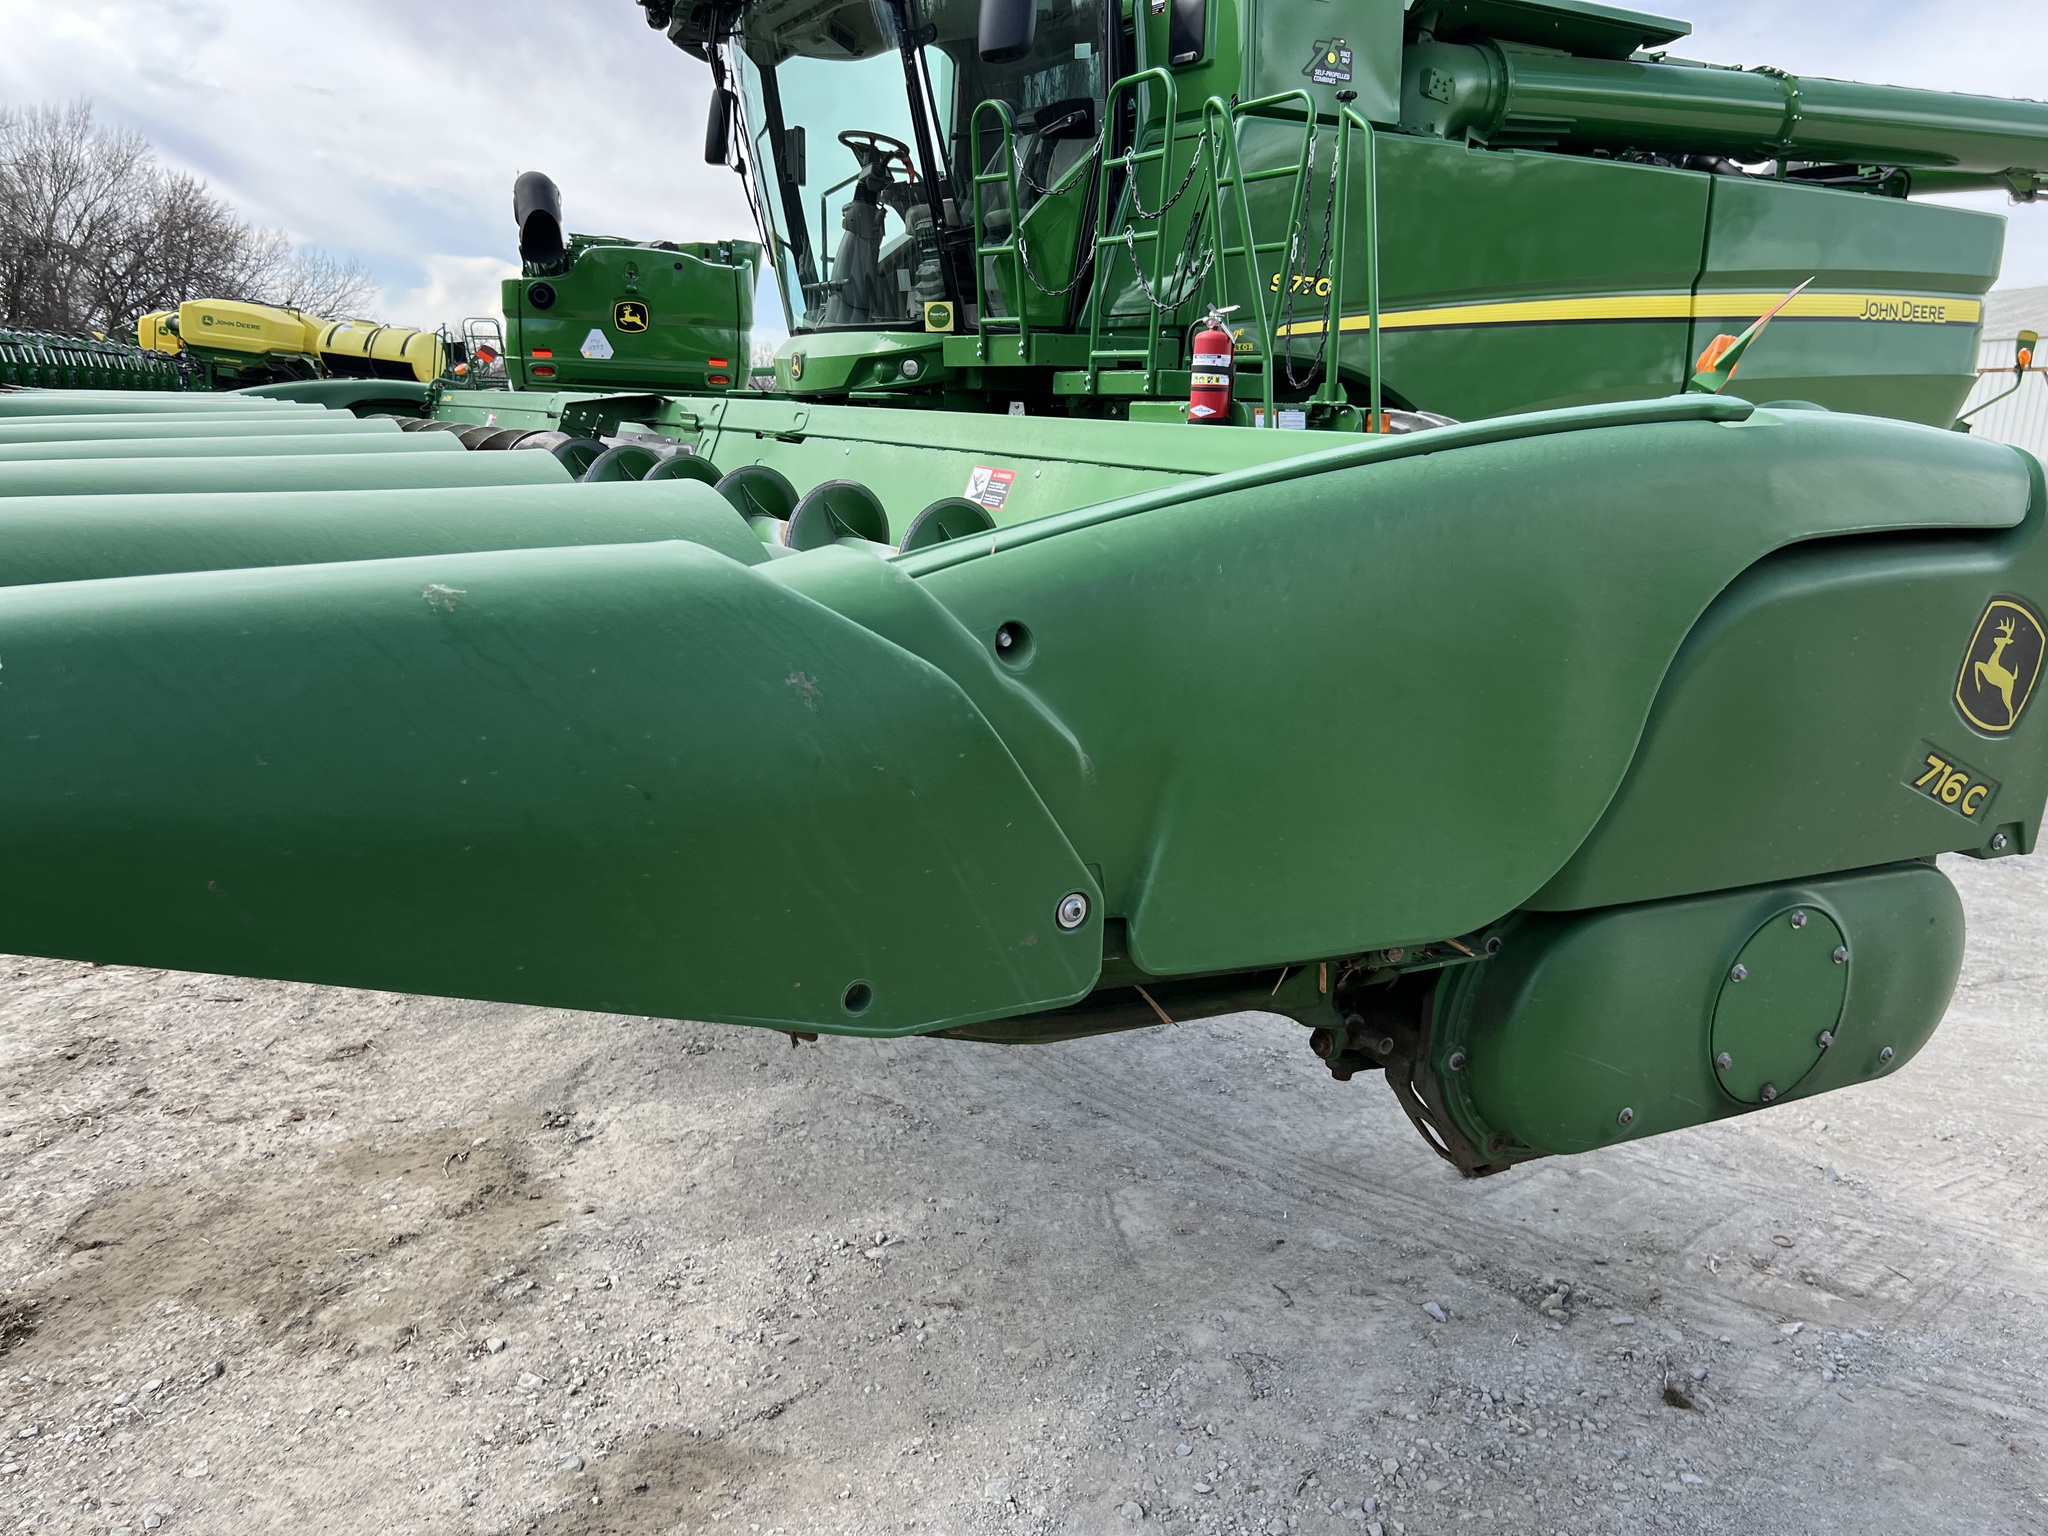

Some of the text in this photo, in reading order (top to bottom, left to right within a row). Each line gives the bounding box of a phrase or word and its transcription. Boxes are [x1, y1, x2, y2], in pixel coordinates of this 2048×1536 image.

[1313, 75, 1337, 84] COMBINES
[1314, 69, 1351, 80] SELF-PROPELLED
[1860, 298, 1946, 320] JOHN DEERE
[215, 319, 261, 330] JOHN DEERE
